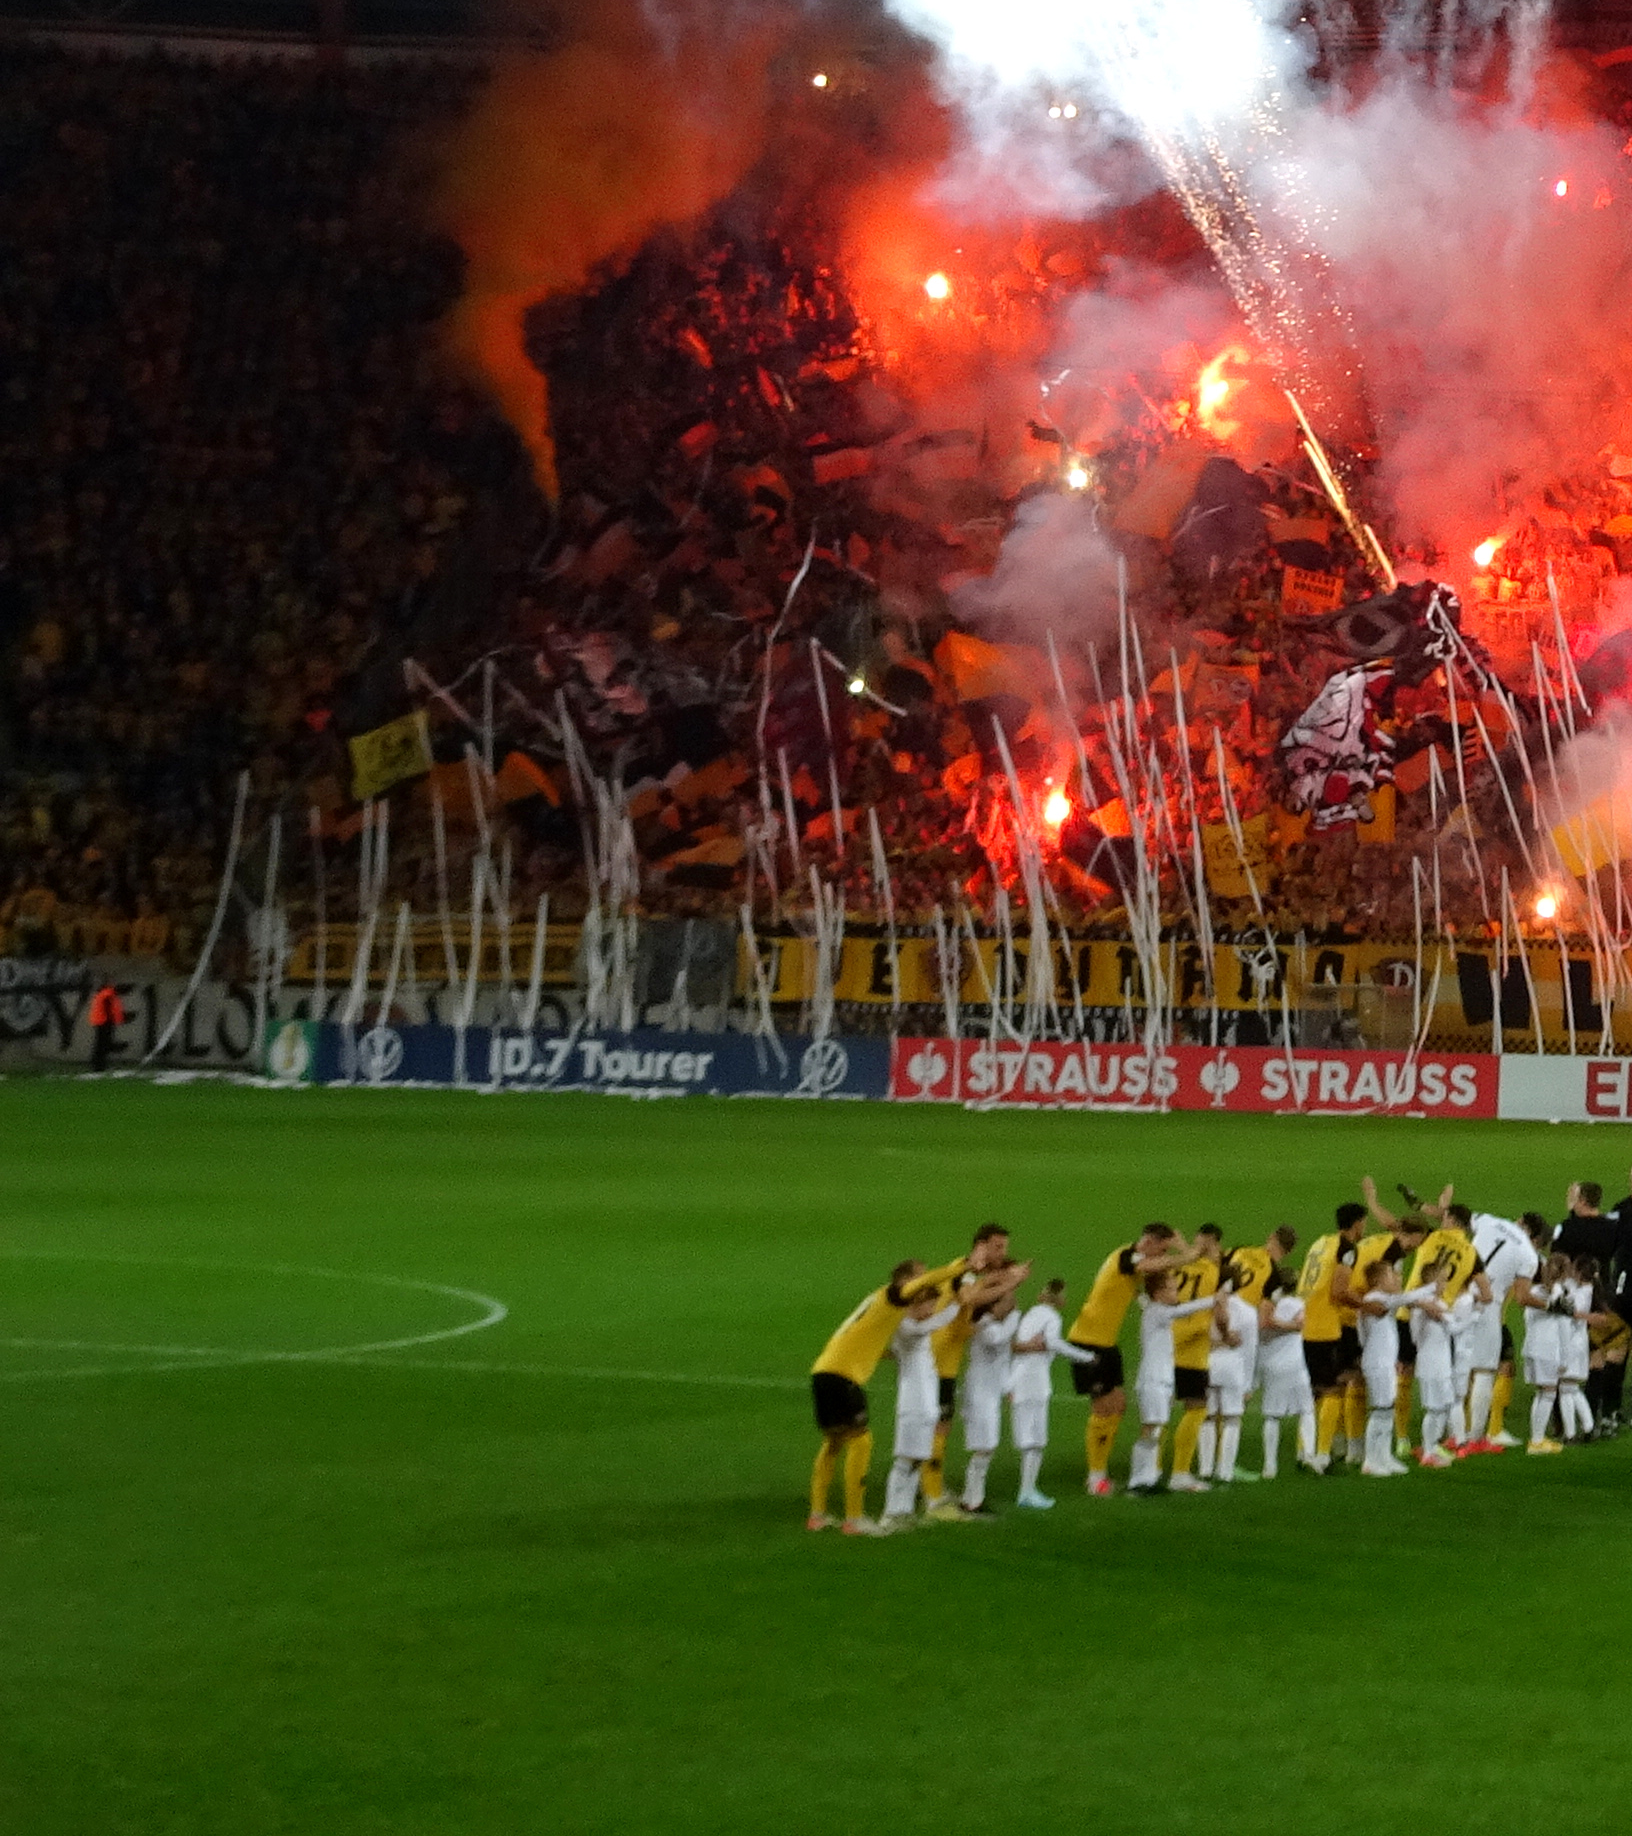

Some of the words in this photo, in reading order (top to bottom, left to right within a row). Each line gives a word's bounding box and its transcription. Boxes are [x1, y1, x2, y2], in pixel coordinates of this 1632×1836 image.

[577, 1038, 714, 1083] Tourer
[966, 1049, 1180, 1099] STRAUSS
[1260, 1058, 1480, 1108] STRAUSS
